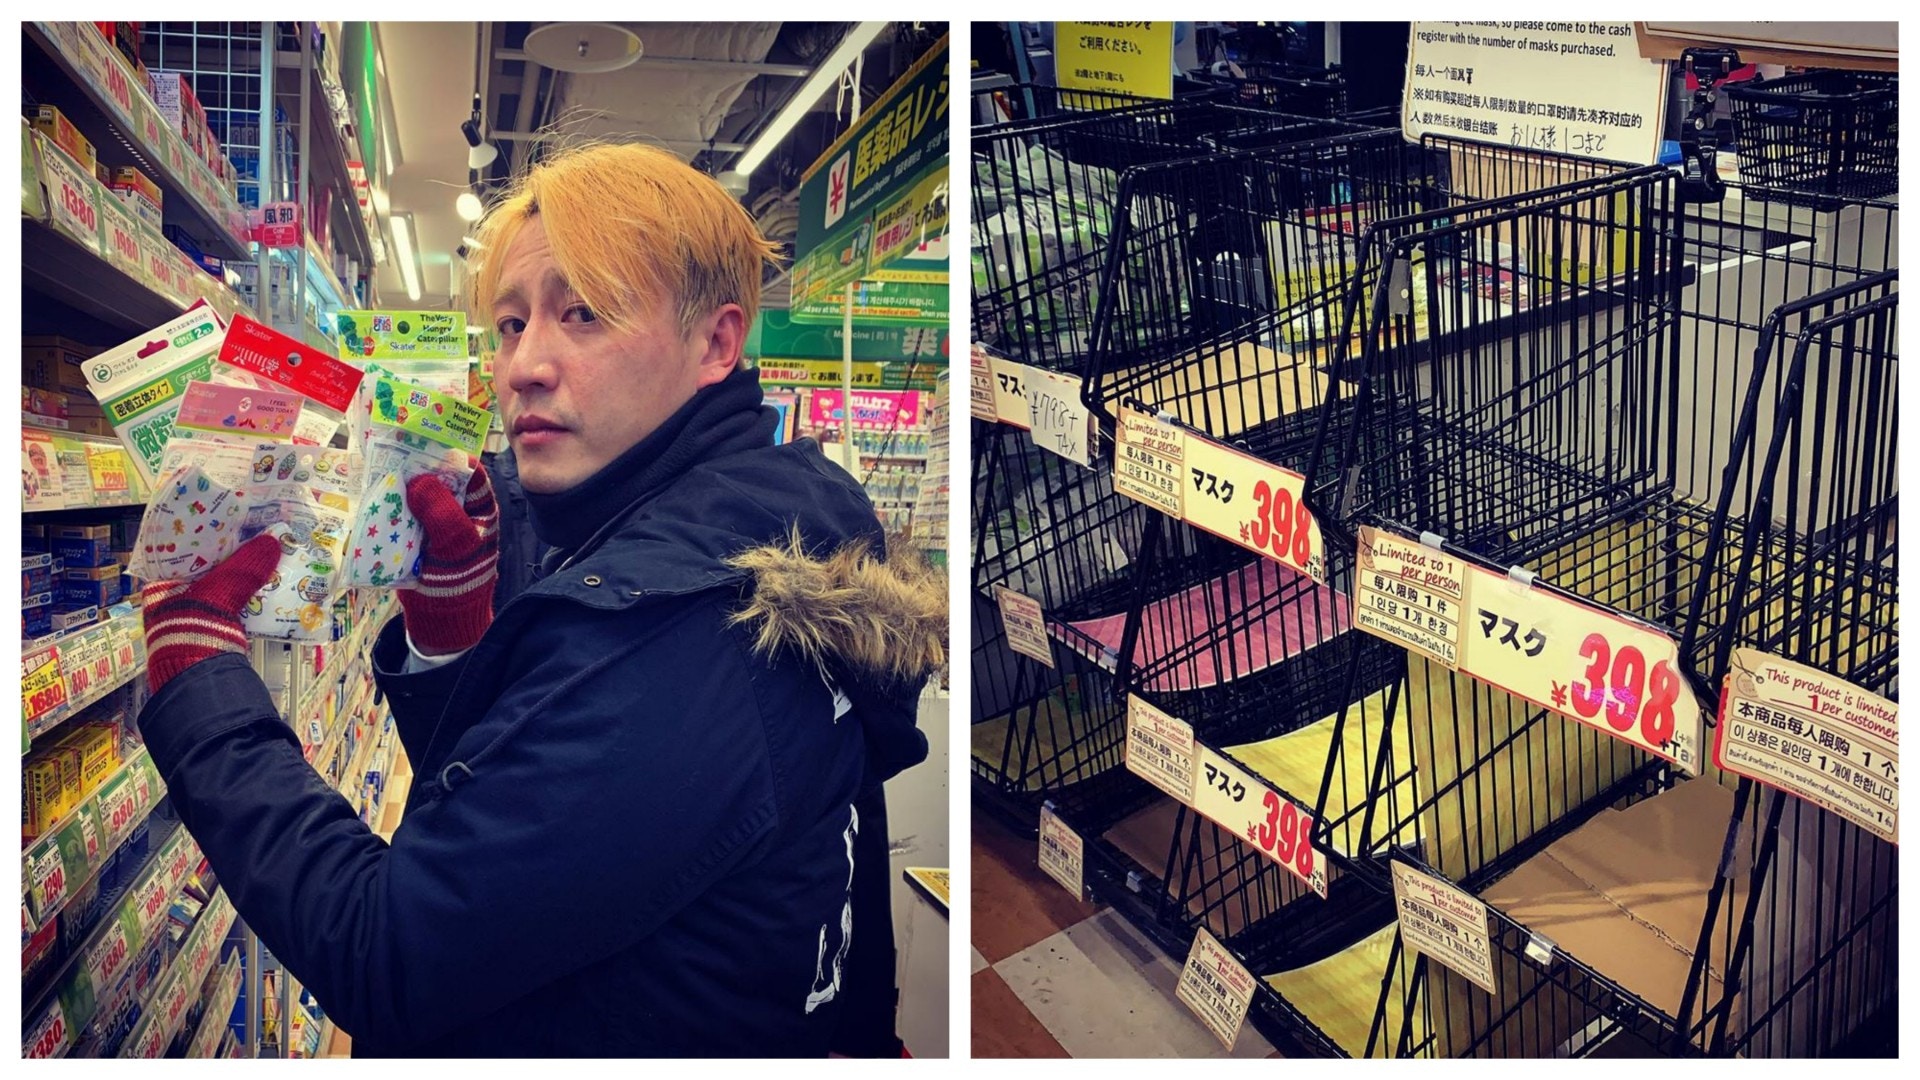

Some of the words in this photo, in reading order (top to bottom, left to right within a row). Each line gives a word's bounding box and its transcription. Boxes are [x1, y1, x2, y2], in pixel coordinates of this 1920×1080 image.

[1513, 20, 1543, 31] please
[1546, 21, 1572, 32] come
[1575, 22, 1586, 33] to
[1589, 21, 1605, 35] the
[1608, 23, 1631, 37] cash
[1079, 35, 1142, 56] ご利用ください。
[1417, 30, 1448, 44] register
[1449, 32, 1466, 44] with
[1467, 33, 1480, 46] the
[1482, 35, 1515, 48] number
[1517, 37, 1528, 50] of
[1529, 39, 1559, 52] masks
[1560, 41, 1616, 57] purchased.
[265, 207, 293, 224] 風邪
[420, 314, 435, 322] The
[243, 323, 273, 342] Skater
[417, 335, 459, 344] Caterpillar
[833, 330, 870, 339] Mecine
[390, 341, 416, 350] Skater
[997, 372, 1027, 400] マス
[114, 382, 171, 417] 密着立体タイプ
[454, 402, 466, 413] The
[463, 405, 482, 419] Very
[421, 417, 443, 432] Skater
[445, 420, 480, 438] Caterpillar
[452, 412, 478, 427] Hungry
[1129, 419, 1158, 437] Limited
[1160, 430, 1170, 440] to
[1055, 433, 1078, 456] TAX
[1143, 436, 1155, 450] per
[1157, 440, 1182, 455] person
[1157, 459, 1162, 470] 1
[1191, 466, 1234, 504] マスク
[1239, 480, 1312, 567] ¥398
[1379, 543, 1426, 567] Limited
[1430, 559, 1444, 571] to
[1447, 562, 1453, 574] 1
[1401, 564, 1422, 580] per
[1424, 571, 1461, 592] person
[1374, 575, 1418, 603] 每人限购
[1424, 595, 1432, 608] 1
[1437, 599, 1447, 615] 件
[1428, 616, 1448, 636] 한정
[1478, 607, 1547, 658] マスク
[71, 667, 89, 695] 880
[1551, 632, 1680, 748] ¥398
[29, 683, 62, 714] 1680
[1765, 667, 1790, 685] This
[1792, 678, 1841, 701] product
[1843, 691, 1853, 707] is
[1856, 694, 1896, 725] limited
[1808, 694, 1818, 711] 1
[1820, 700, 1842, 717] per
[1738, 701, 1850, 757] 本商品每人限购
[1862, 751, 1871, 768] 1
[1881, 760, 1899, 783] 个。
[1733, 724, 1745, 739] 이
[1747, 729, 1780, 751] 상품은
[1781, 739, 1813, 763] 일인당
[1818, 755, 1827, 771] 1
[1831, 759, 1850, 782] 개에
[1852, 772, 1896, 806] 한합니다.
[1204, 762, 1246, 803] マスク
[112, 797, 134, 833] 980
[1877, 811, 1884, 823] 1
[1247, 791, 1314, 878] ¥398
[1421, 882, 1445, 899] product
[1452, 893, 1473, 911] limited
[1438, 898, 1448, 909] per
[1446, 936, 1452, 947] 1
[1463, 932, 1470, 943] 1
[101, 938, 126, 979] 1380
[1229, 997, 1235, 1008] 1
